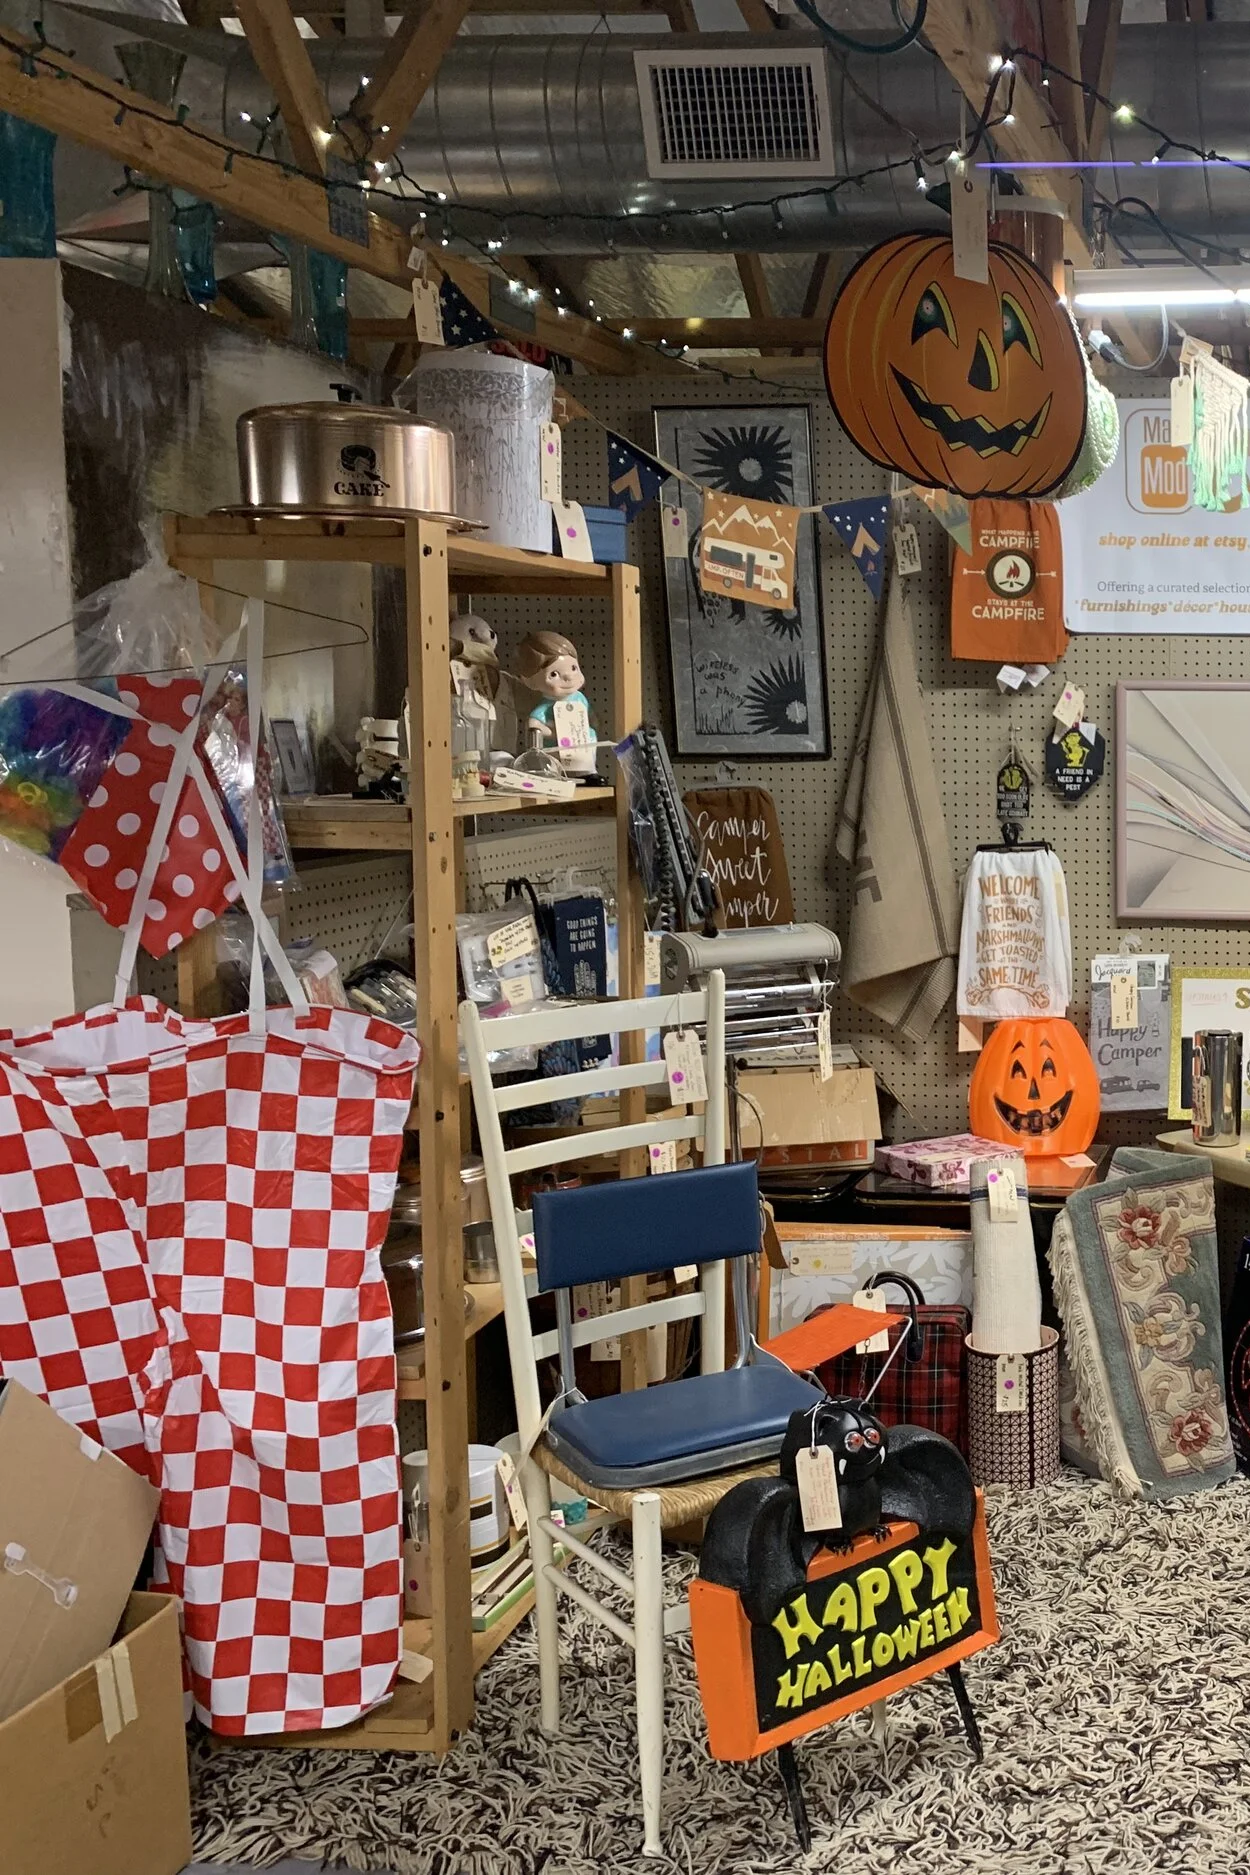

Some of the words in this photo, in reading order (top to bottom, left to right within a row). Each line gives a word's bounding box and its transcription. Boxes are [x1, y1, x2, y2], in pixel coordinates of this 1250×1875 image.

[1143, 415, 1171, 443] Ma
[1144, 457, 1187, 496] Mod
[334, 482, 384, 497] CAKE
[980, 535, 1040, 549] CAMPFIE
[1098, 533, 1136, 549] shop
[1140, 533, 1190, 547] online
[1194, 534, 1209, 547] at
[1097, 581, 1145, 594] Offering
[1147, 585, 1154, 593] a
[1156, 582, 1200, 593] curated
[971, 605, 1045, 621] CAMPFIRE
[1080, 600, 1168, 615] furnishings
[1062, 768, 1084, 776] FRIEND
[1086, 768, 1093, 776] IN
[1066, 783, 1080, 791] PEST
[978, 874, 1040, 900] WELCOME
[724, 892, 779, 928] mper
[985, 905, 1035, 924] FRIENDS
[977, 928, 1045, 952] MARSHMALLOWS
[981, 949, 996, 963] GET
[1000, 944, 1038, 964] TOASTED
[978, 965, 1009, 987] SAME
[1012, 965, 1037, 988] TIME
[1098, 1043, 1162, 1066] Camper
[772, 1537, 957, 1660] HAPPY
[775, 1586, 972, 1709] HALLOWEEN
